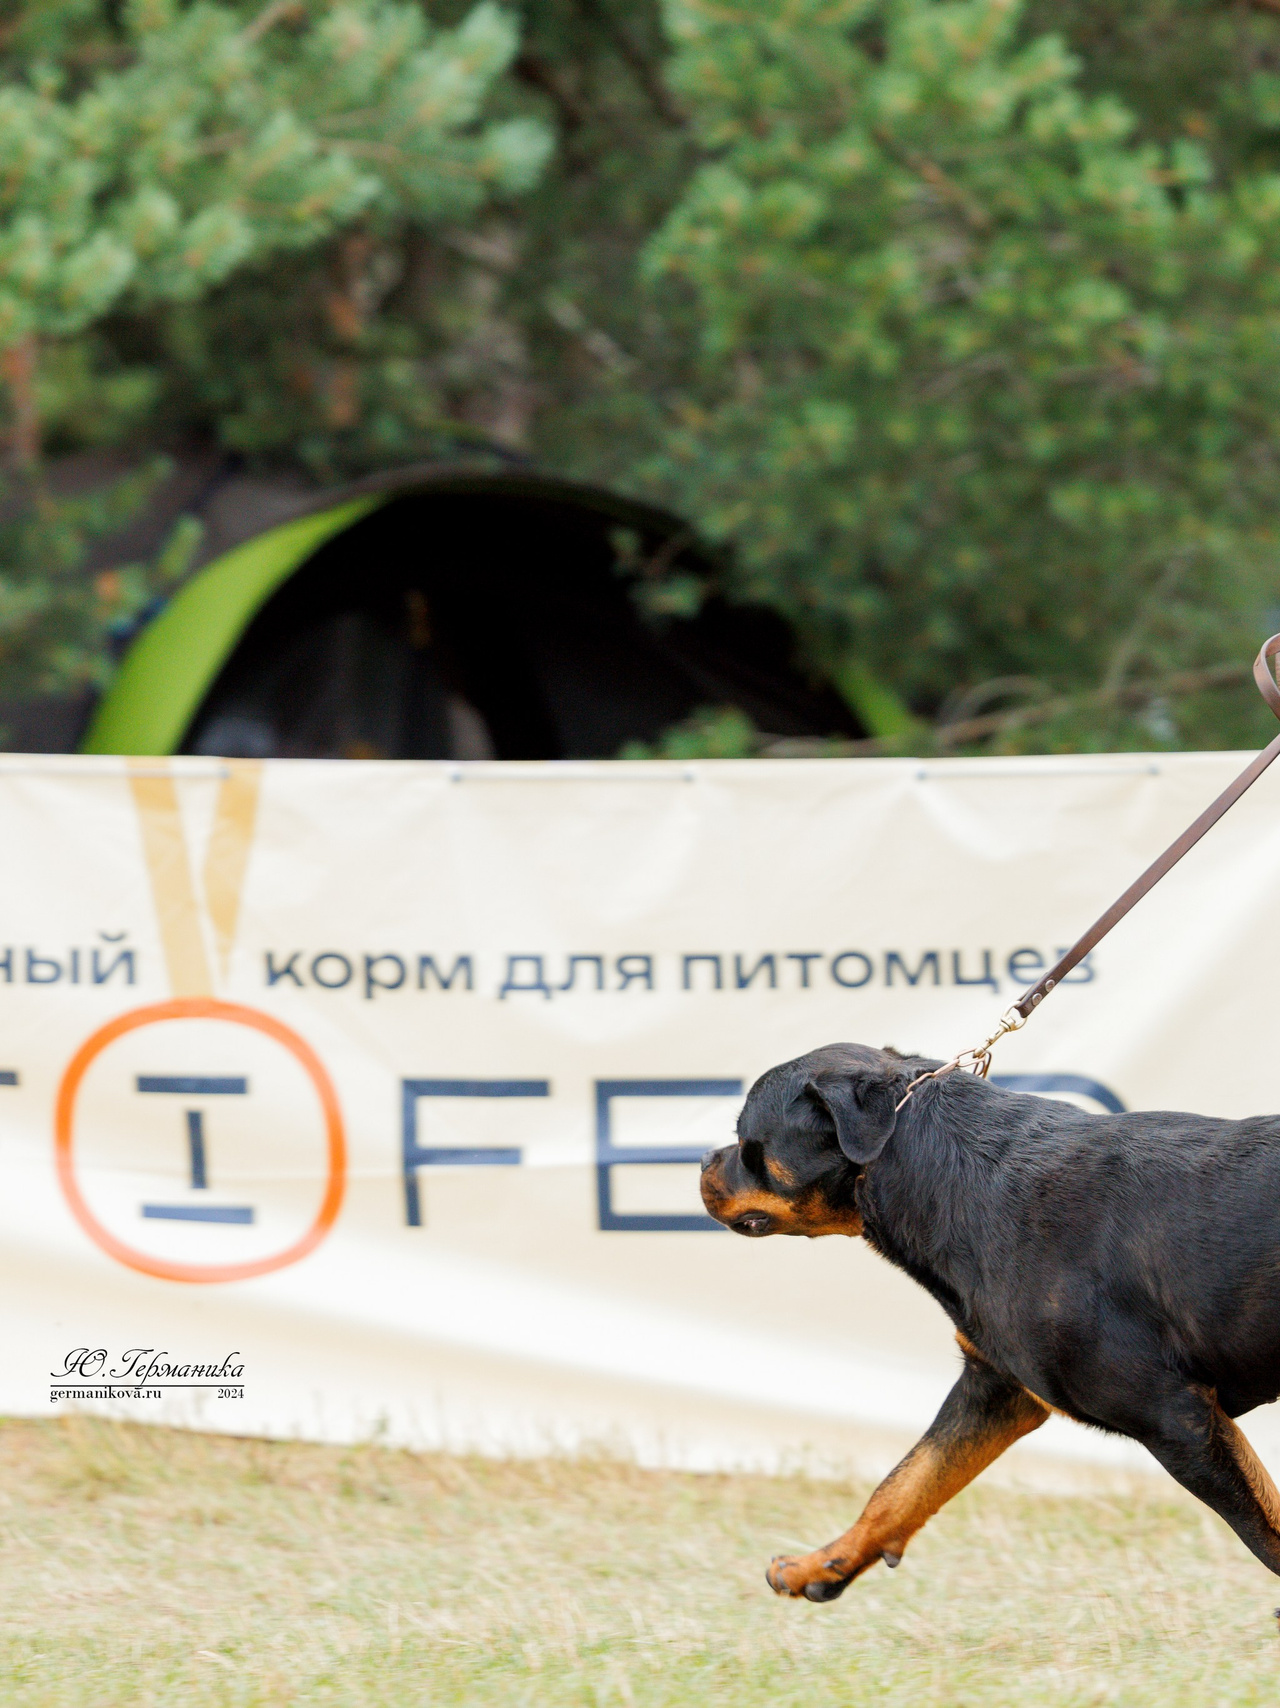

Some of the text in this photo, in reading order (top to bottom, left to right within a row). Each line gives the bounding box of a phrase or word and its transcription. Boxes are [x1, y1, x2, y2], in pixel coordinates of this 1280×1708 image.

[266, 949, 474, 998] корм
[499, 951, 656, 999] для
[682, 946, 1096, 994] питомцев
